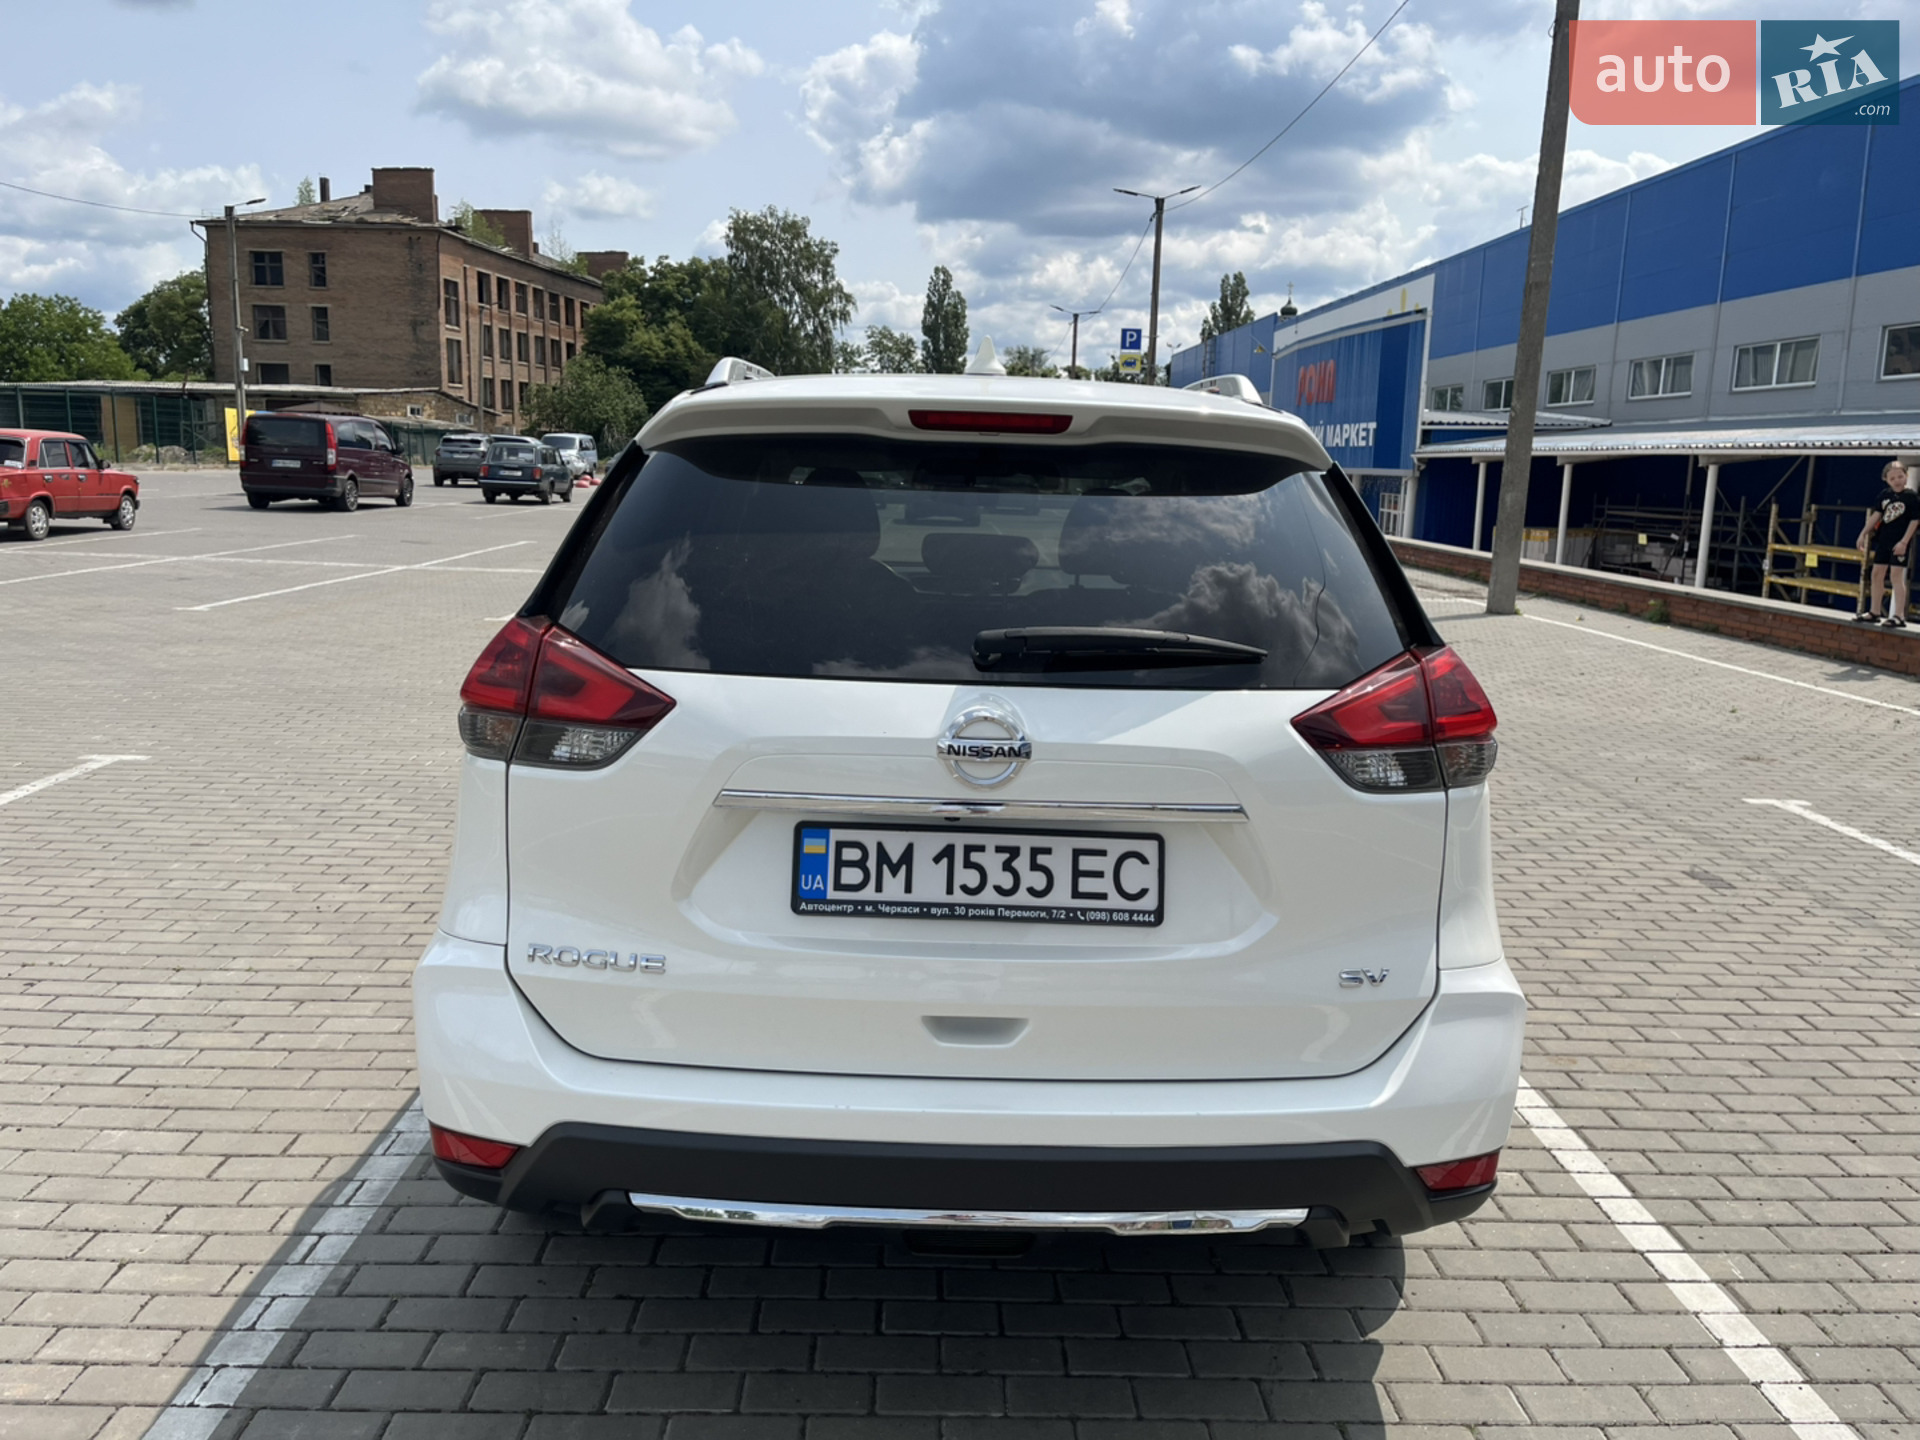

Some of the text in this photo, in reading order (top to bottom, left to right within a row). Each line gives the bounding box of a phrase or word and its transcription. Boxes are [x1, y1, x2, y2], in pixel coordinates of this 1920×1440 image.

[1125, 330, 1137, 348] P
[1325, 422, 1377, 448] МАРКЕТ
[946, 743, 1021, 758] NISSAN
[832, 840, 1150, 901] BM 1535 EC
[801, 874, 825, 892] UA
[799, 901, 854, 914] Автоцентр
[878, 903, 920, 915] Черкаси
[954, 906, 966, 915] 30
[968, 907, 995, 917] років
[1051, 909, 1066, 919] 7/2
[1112, 911, 1130, 921] 608
[1132, 913, 1155, 922] 4444
[527, 943, 667, 975] ROGUE
[1339, 967, 1390, 989] SV
